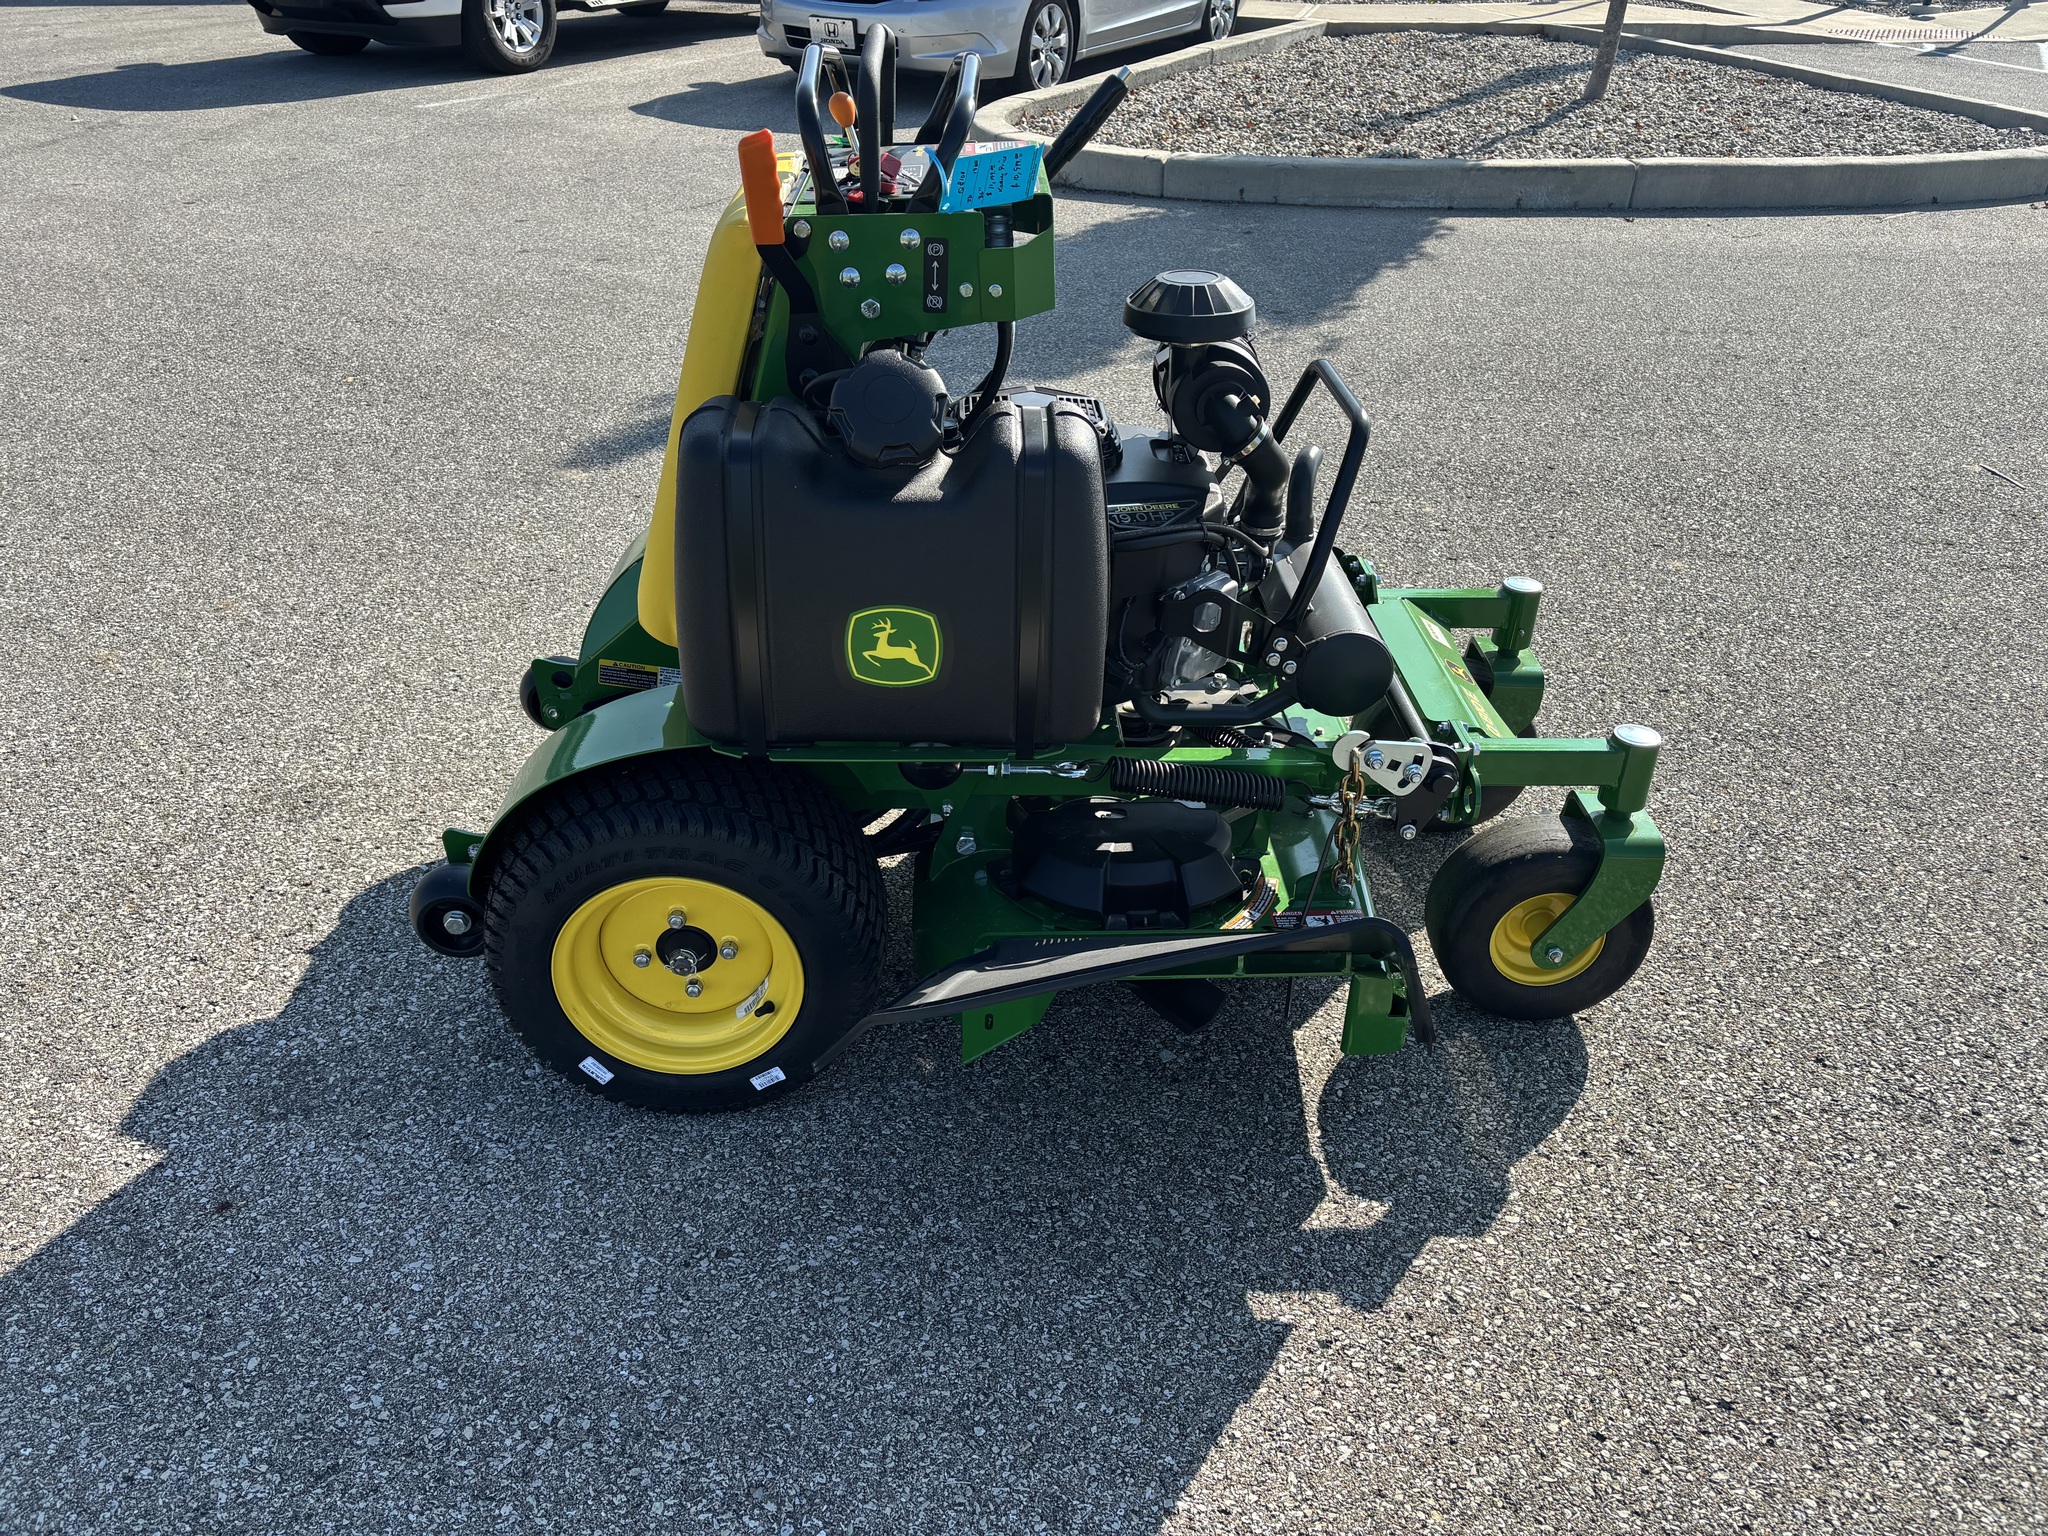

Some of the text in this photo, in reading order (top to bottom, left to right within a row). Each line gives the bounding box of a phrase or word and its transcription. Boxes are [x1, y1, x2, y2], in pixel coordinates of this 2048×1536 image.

[820, 38, 848, 47] HONDA
[1143, 503, 1180, 511] DEERE
[1111, 511, 1175, 524] 19.0 HP
[618, 662, 646, 670] CAUTION
[543, 848, 632, 905] MULTI
[642, 845, 750, 873] TRAC
